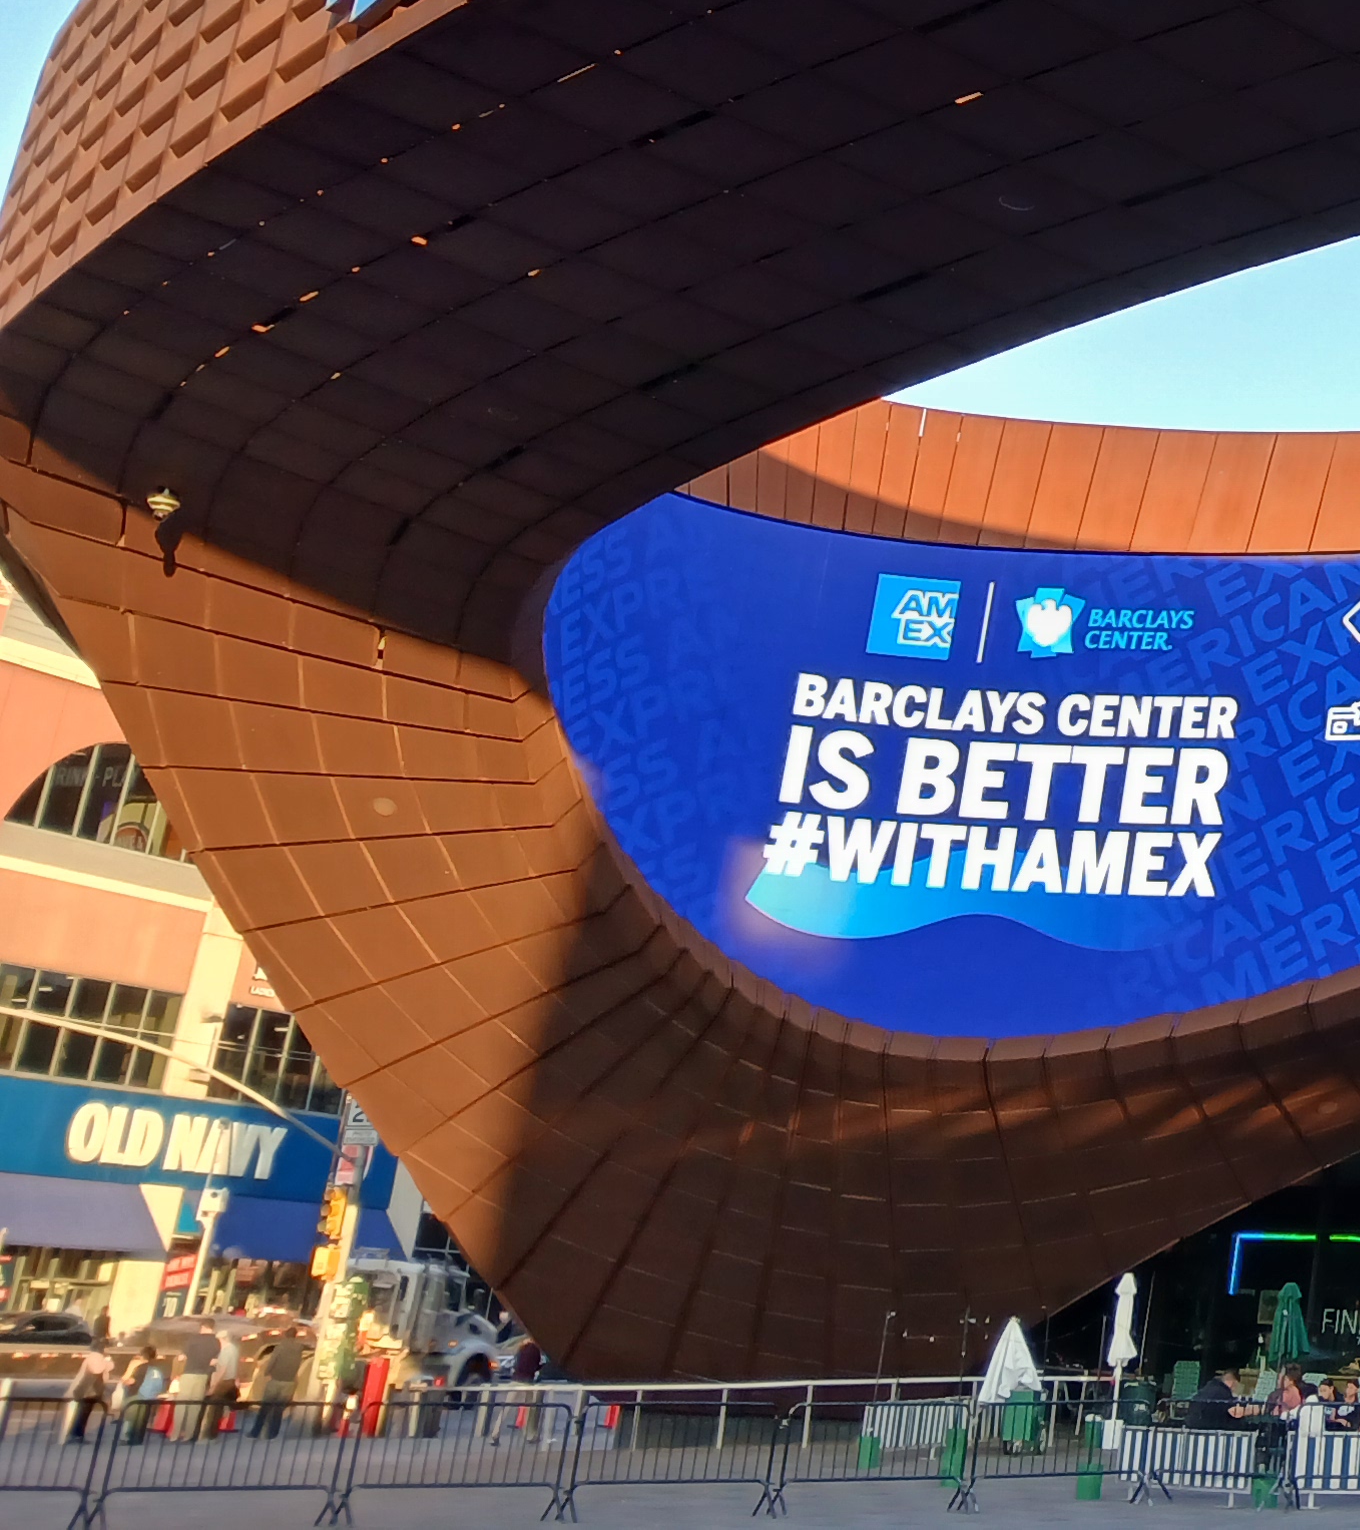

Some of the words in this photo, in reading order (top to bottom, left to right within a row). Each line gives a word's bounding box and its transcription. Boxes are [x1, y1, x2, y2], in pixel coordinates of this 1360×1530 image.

[1088, 609, 1195, 630] BARCLAYS
[792, 672, 1047, 735] BARCLAYS
[1058, 693, 1238, 739] CENTER
[778, 724, 875, 811] IS
[897, 737, 1229, 825] BETTER
[763, 811, 1223, 898] #WITHAMEX
[67, 1102, 164, 1166] OLD
[162, 1113, 288, 1179] NAVY
